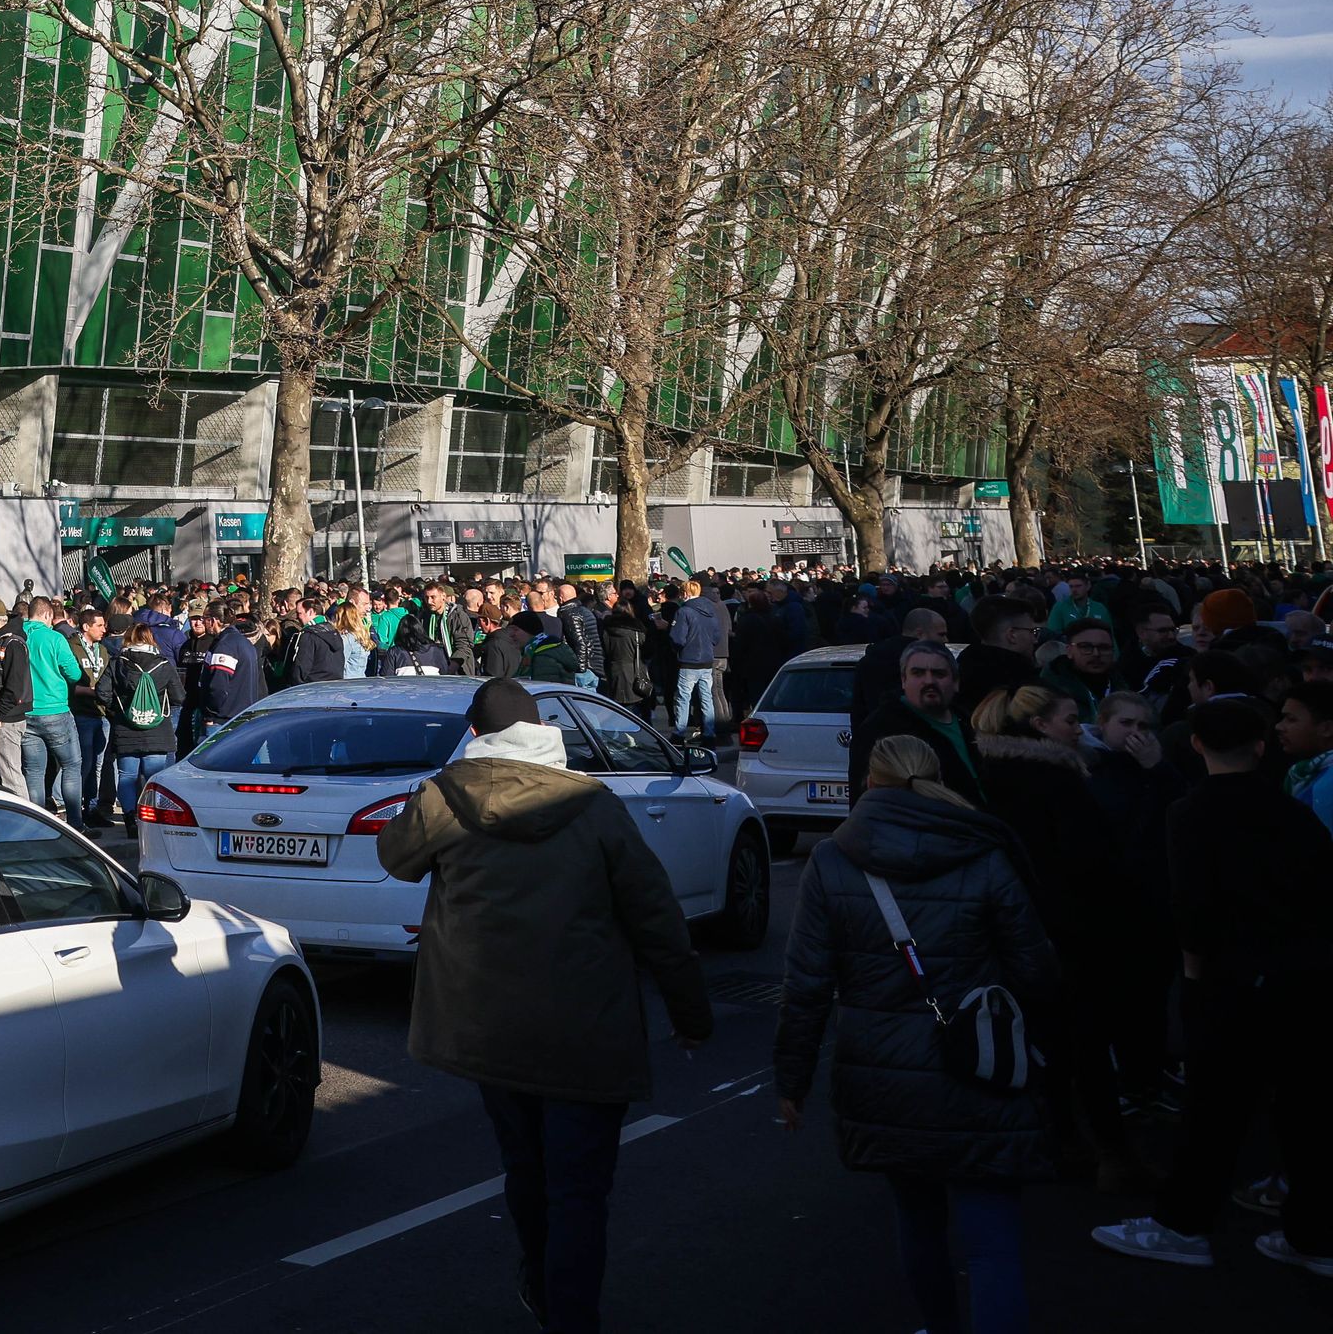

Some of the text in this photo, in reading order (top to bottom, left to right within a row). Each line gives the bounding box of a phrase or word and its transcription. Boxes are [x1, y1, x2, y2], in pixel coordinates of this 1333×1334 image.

[219, 516, 242, 527] Kassen
[68, 526, 83, 537] West
[123, 526, 153, 537] Block West
[820, 785, 835, 798] PL
[233, 834, 244, 854] W
